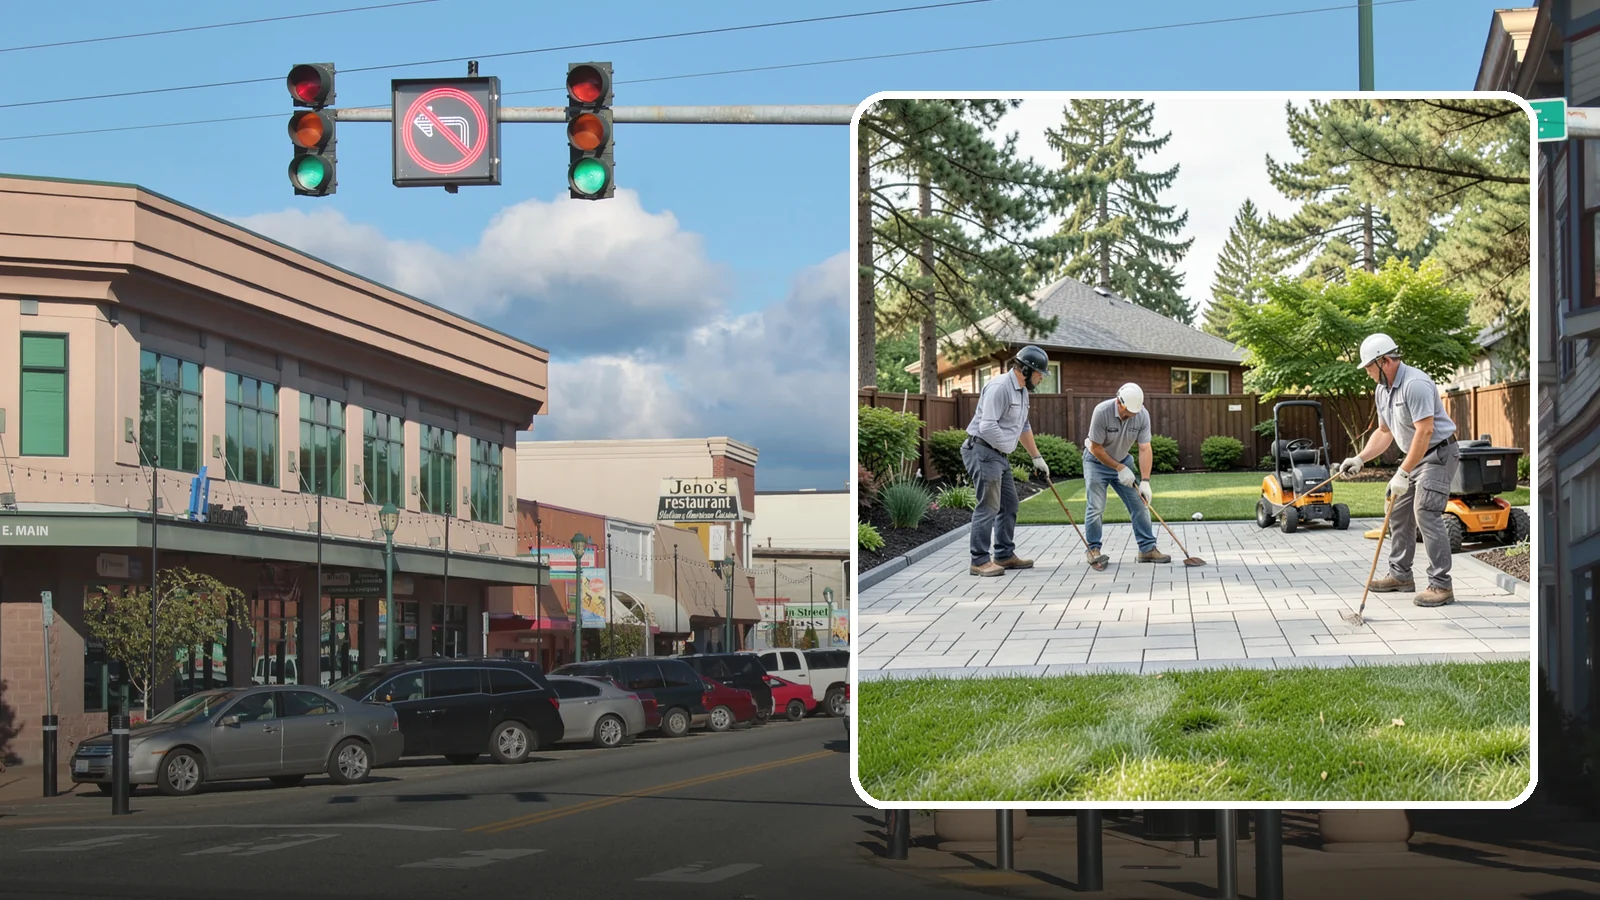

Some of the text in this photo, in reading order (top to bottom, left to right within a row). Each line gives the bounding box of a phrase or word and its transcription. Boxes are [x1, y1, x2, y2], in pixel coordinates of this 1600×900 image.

[670, 480, 727, 494] Jeno's
[665, 496, 731, 509] restaurant
[659, 510, 681, 519] Italian
[686, 510, 714, 519] American
[715, 509, 737, 519] Cuisine
[2, 525, 49, 536] E. MAIN
[797, 607, 829, 616] Street
